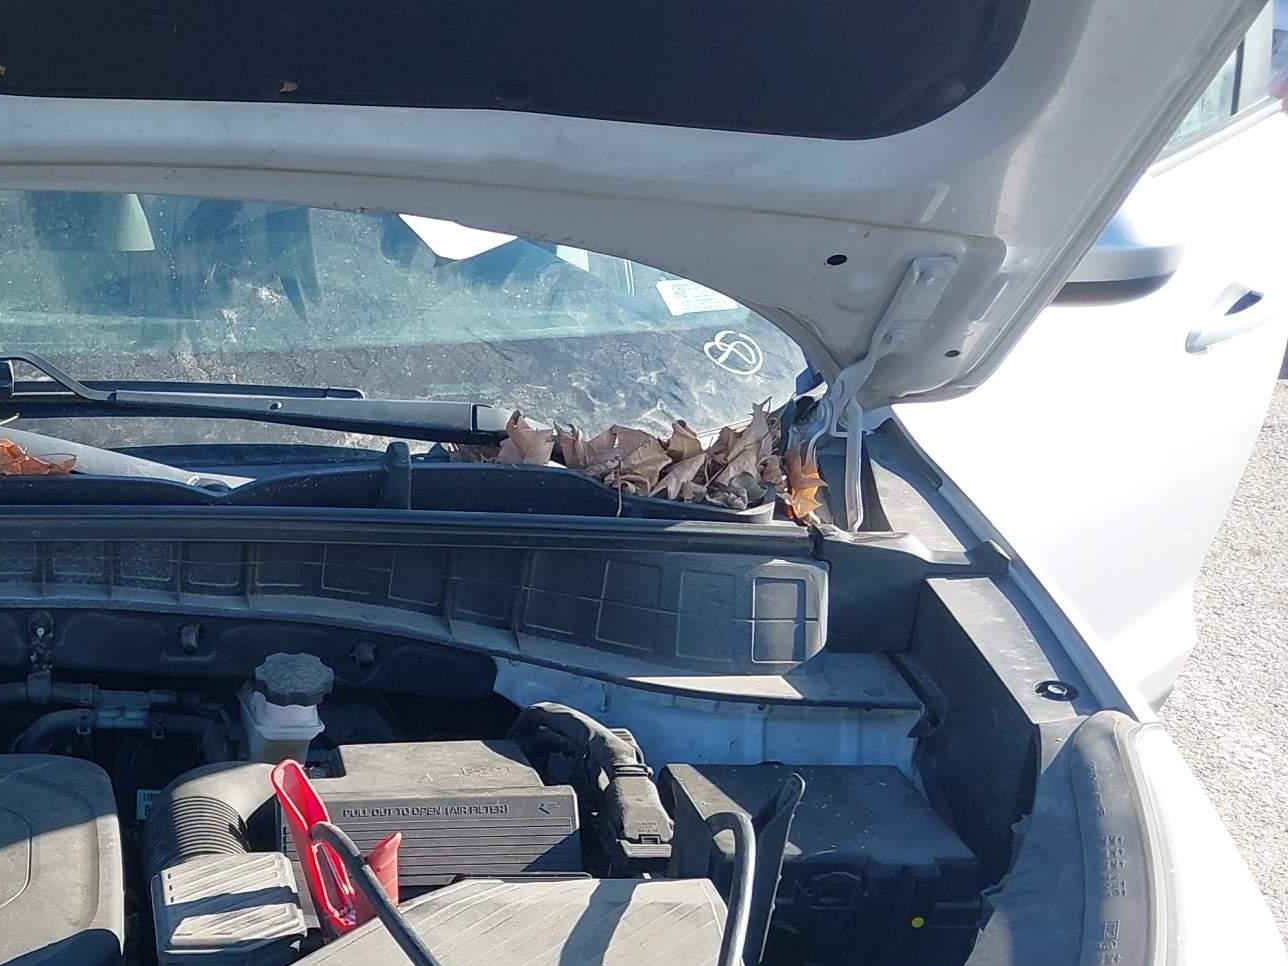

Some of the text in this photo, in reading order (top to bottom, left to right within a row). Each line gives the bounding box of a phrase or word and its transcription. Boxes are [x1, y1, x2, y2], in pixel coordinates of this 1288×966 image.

[342, 808, 369, 818] PULL
[371, 807, 393, 817] OUT
[395, 807, 410, 816] TO
[411, 806, 441, 816] OPEN
